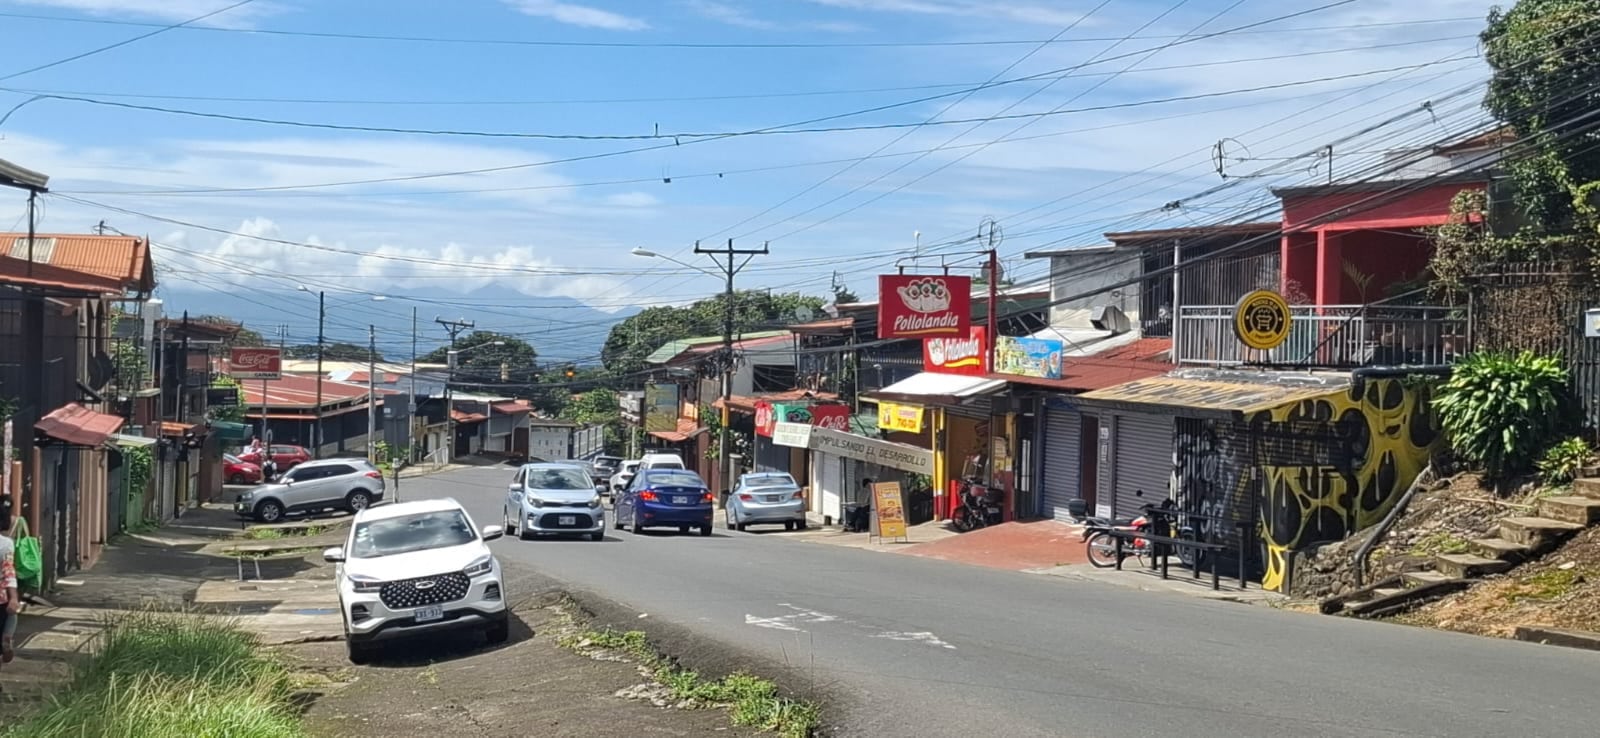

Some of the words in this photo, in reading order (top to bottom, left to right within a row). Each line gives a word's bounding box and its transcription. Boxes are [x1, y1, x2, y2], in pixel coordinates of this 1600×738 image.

[893, 312, 959, 331] Pollolandia
[866, 446, 876, 457] EL
[879, 448, 927, 466] DESARROLLO
